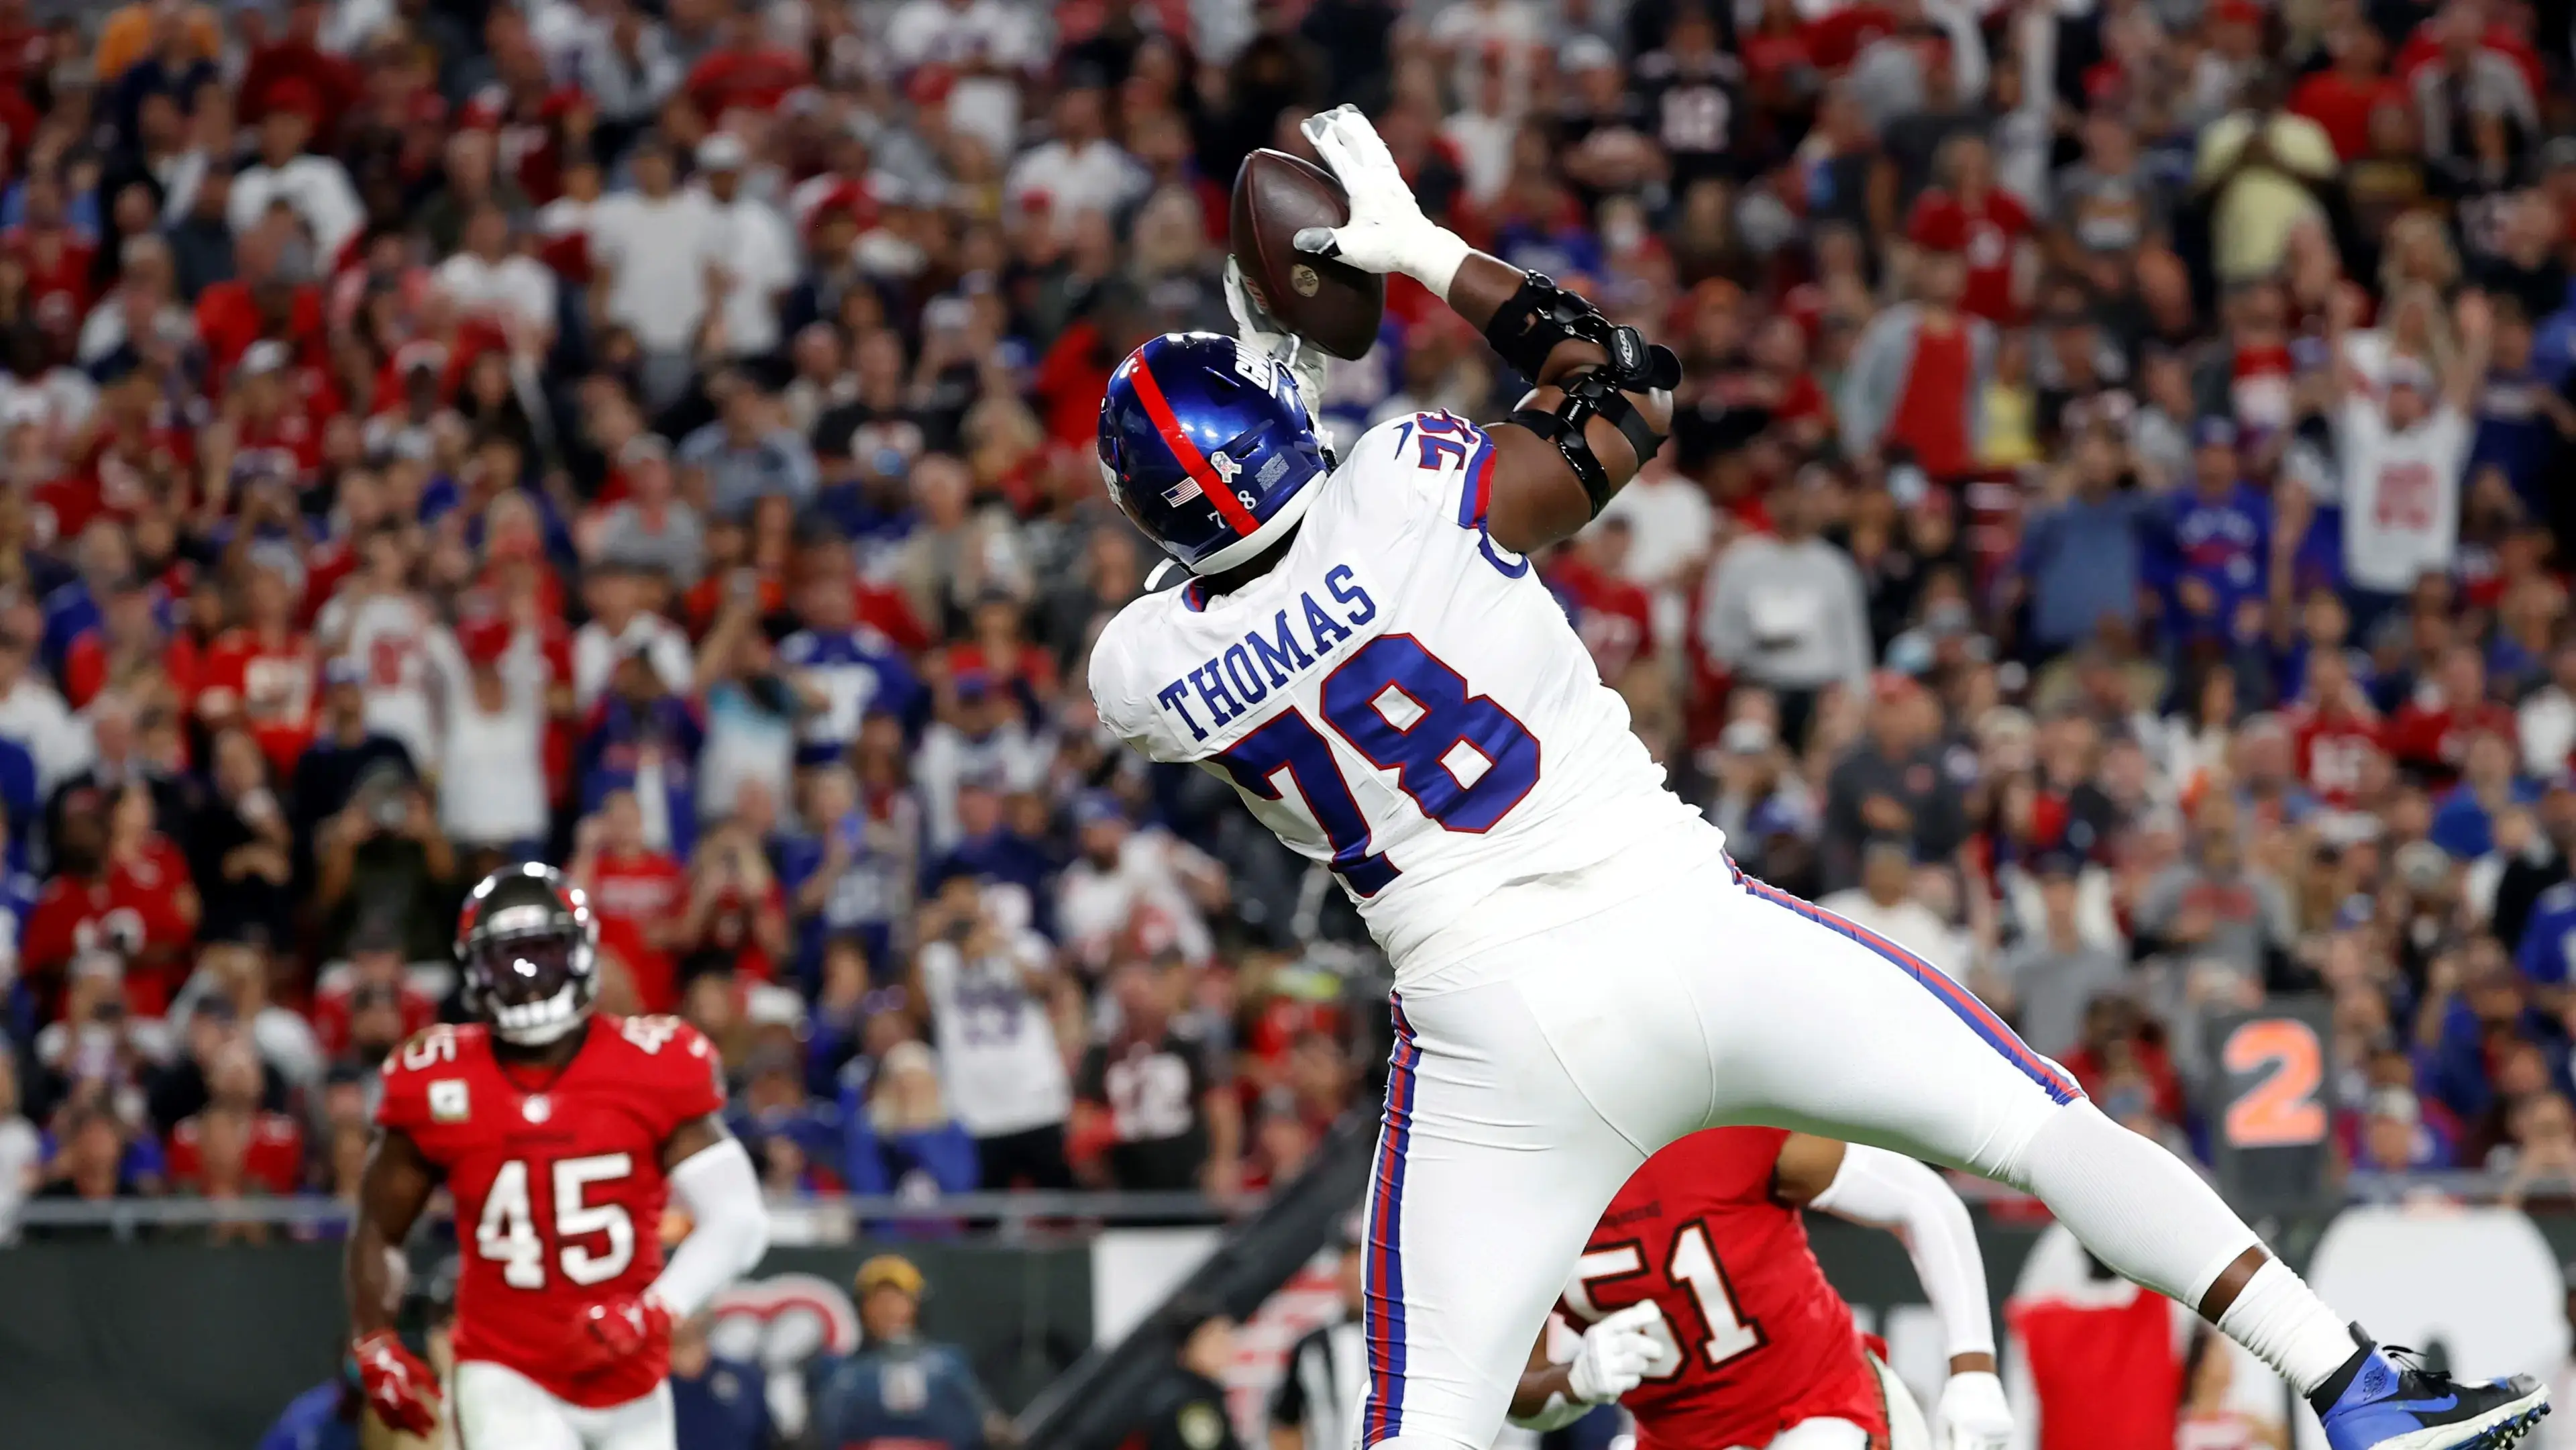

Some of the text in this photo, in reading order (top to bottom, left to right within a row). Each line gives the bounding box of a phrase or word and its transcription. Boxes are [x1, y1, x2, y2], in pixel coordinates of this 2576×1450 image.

[1157, 564, 1376, 742] THOMAS
[1204, 632, 1541, 898] 78
[2222, 1018, 2328, 1149] 2
[475, 1151, 633, 1291] 45
[1555, 1216, 1771, 1384] 51
